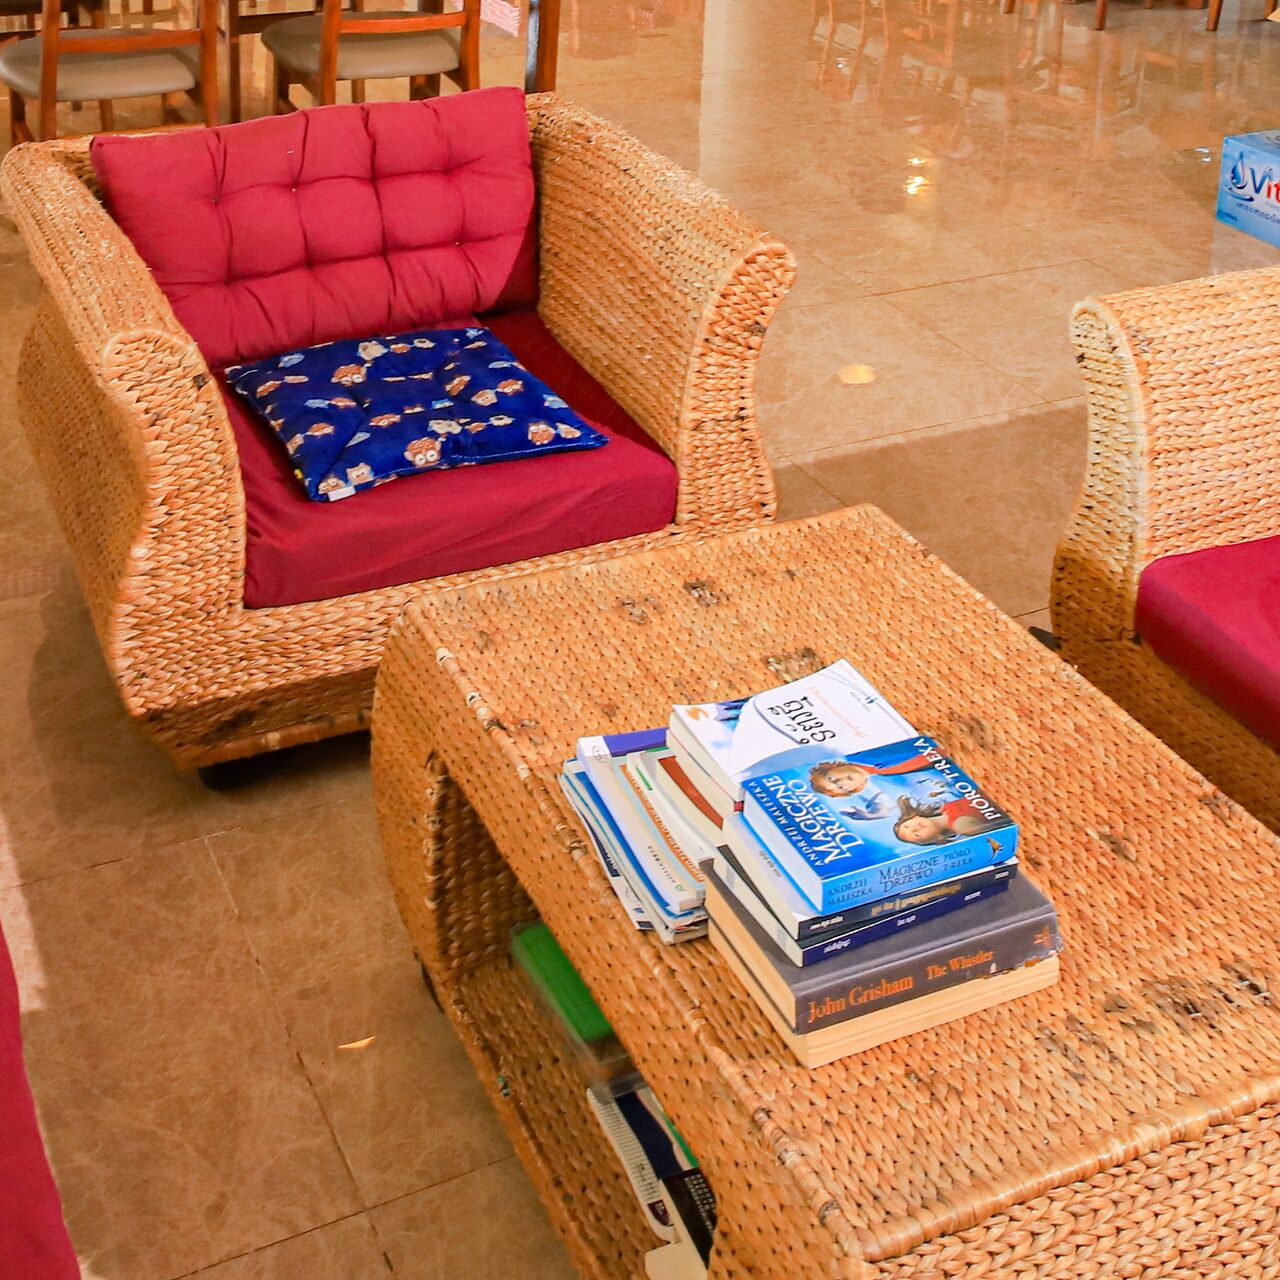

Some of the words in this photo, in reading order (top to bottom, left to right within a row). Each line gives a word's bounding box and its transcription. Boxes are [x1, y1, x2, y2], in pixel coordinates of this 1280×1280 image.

[749, 781, 789, 825] MALESZKA
[762, 775, 852, 865] MAGICZNE
[787, 778, 864, 853] DRZEWO
[785, 826, 824, 867] ANDRZEJ
[879, 856, 939, 884] MAGICZNE
[881, 867, 934, 893] DRZEWO
[807, 998, 846, 1024] John
[848, 975, 914, 1007] Grisham
[926, 964, 948, 981] The
